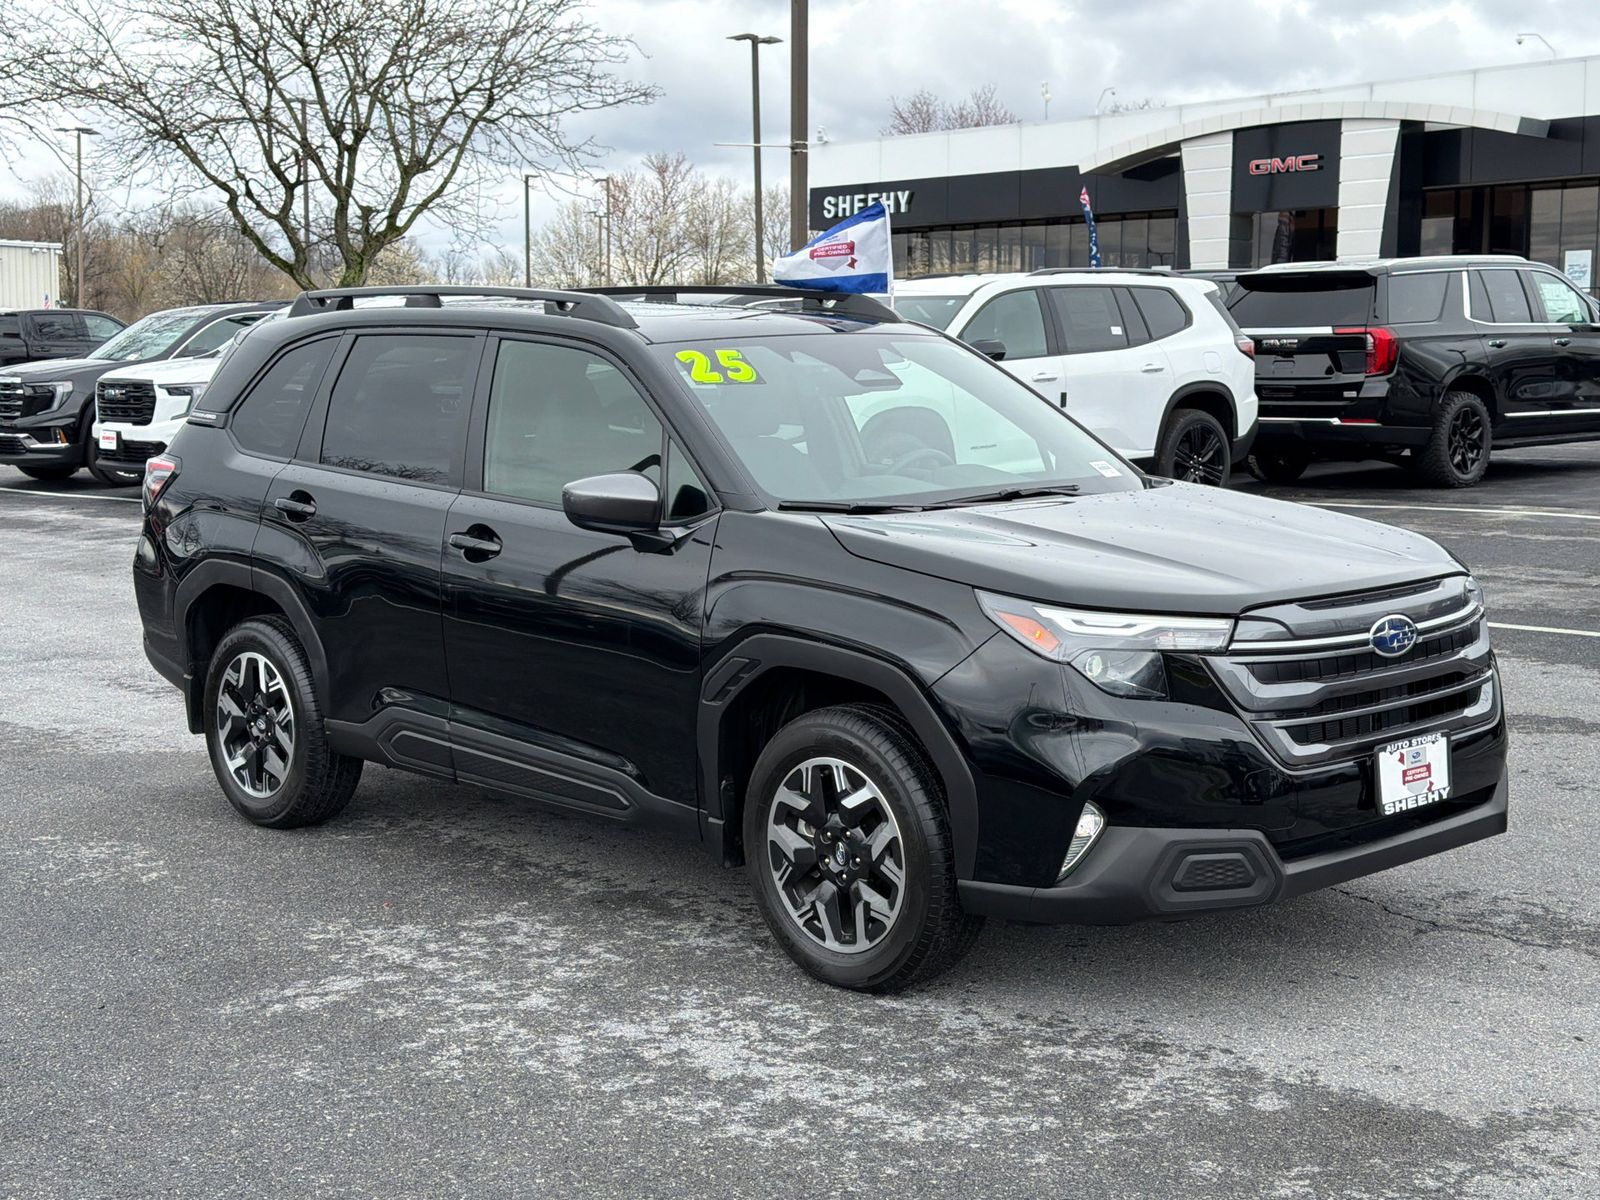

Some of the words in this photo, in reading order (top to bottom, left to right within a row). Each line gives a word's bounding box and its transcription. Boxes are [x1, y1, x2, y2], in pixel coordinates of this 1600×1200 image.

[1249, 154, 1319, 175] GMC
[823, 190, 910, 219] SHEEHY
[674, 349, 757, 384] 25
[1385, 740, 1410, 754] AUTO
[1411, 733, 1441, 748] STORES
[1384, 786, 1451, 816] SHEEHY
